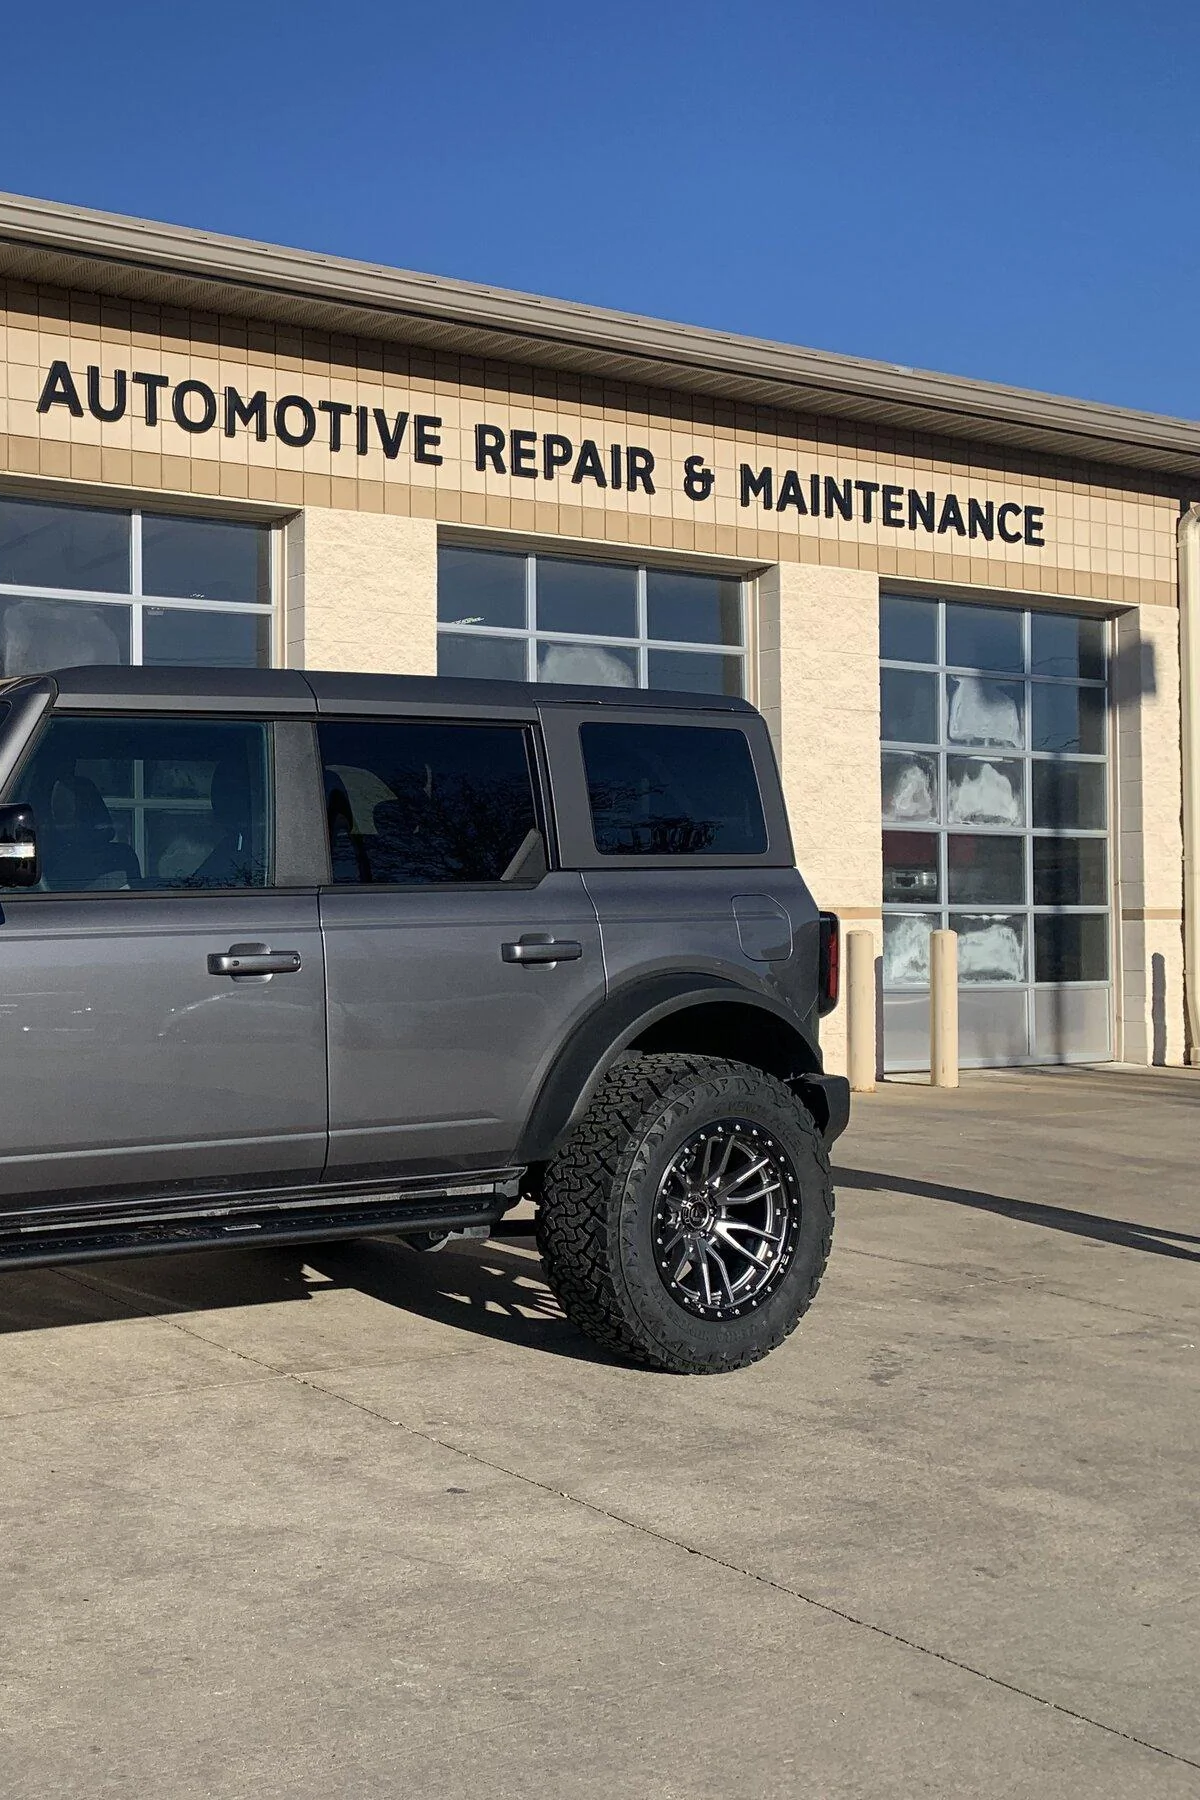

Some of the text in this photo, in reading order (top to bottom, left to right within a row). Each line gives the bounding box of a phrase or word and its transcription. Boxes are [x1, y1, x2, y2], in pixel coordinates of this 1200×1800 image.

[36, 360, 1046, 547] AUTOMOTIVE REPAIR & MAINTENANCE
